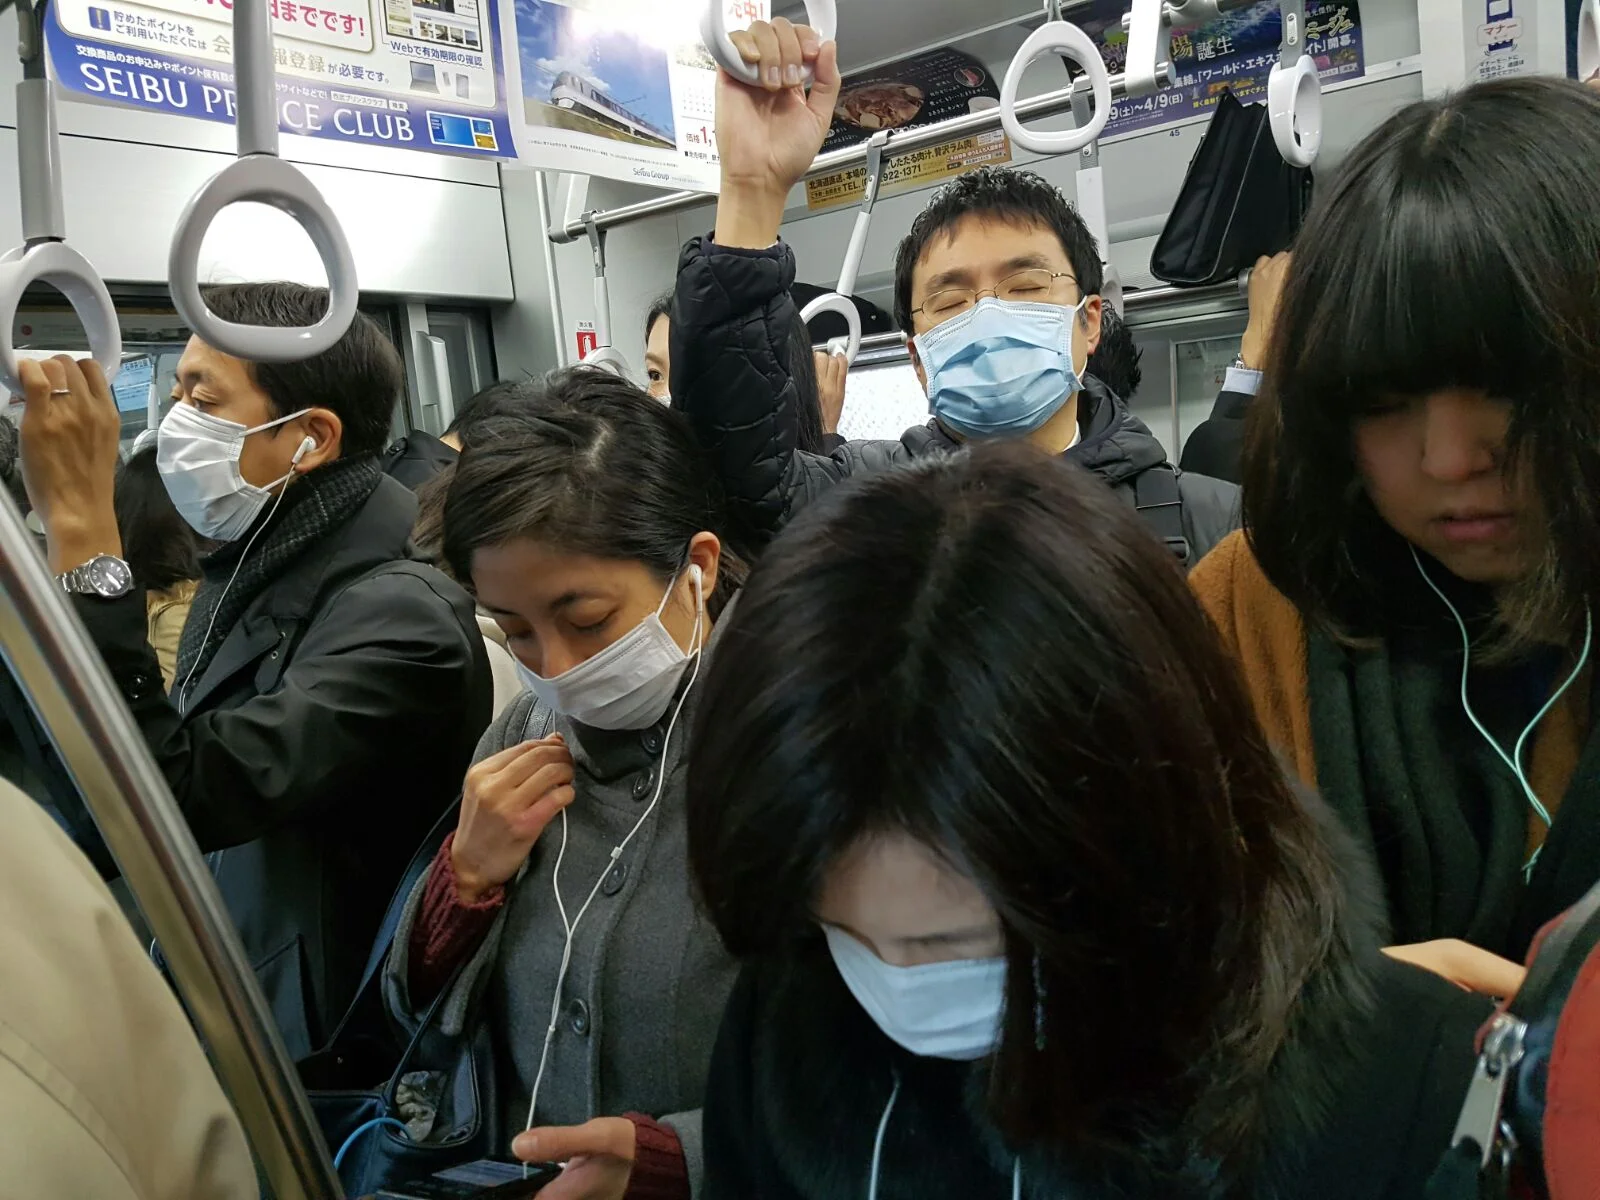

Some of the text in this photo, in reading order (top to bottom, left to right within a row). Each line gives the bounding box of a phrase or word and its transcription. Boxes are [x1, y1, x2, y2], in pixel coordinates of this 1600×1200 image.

[114, 10, 195, 36] 貯めたポイントを
[1484, 24, 1518, 35] マナー
[115, 24, 208, 50] ご利用いただくには
[390, 40, 483, 67] Webで有効期限の確認
[80, 62, 415, 142] SEIBU PRCE CLUB
[1108, 94, 1184, 120] 9(土)～4/9(日)
